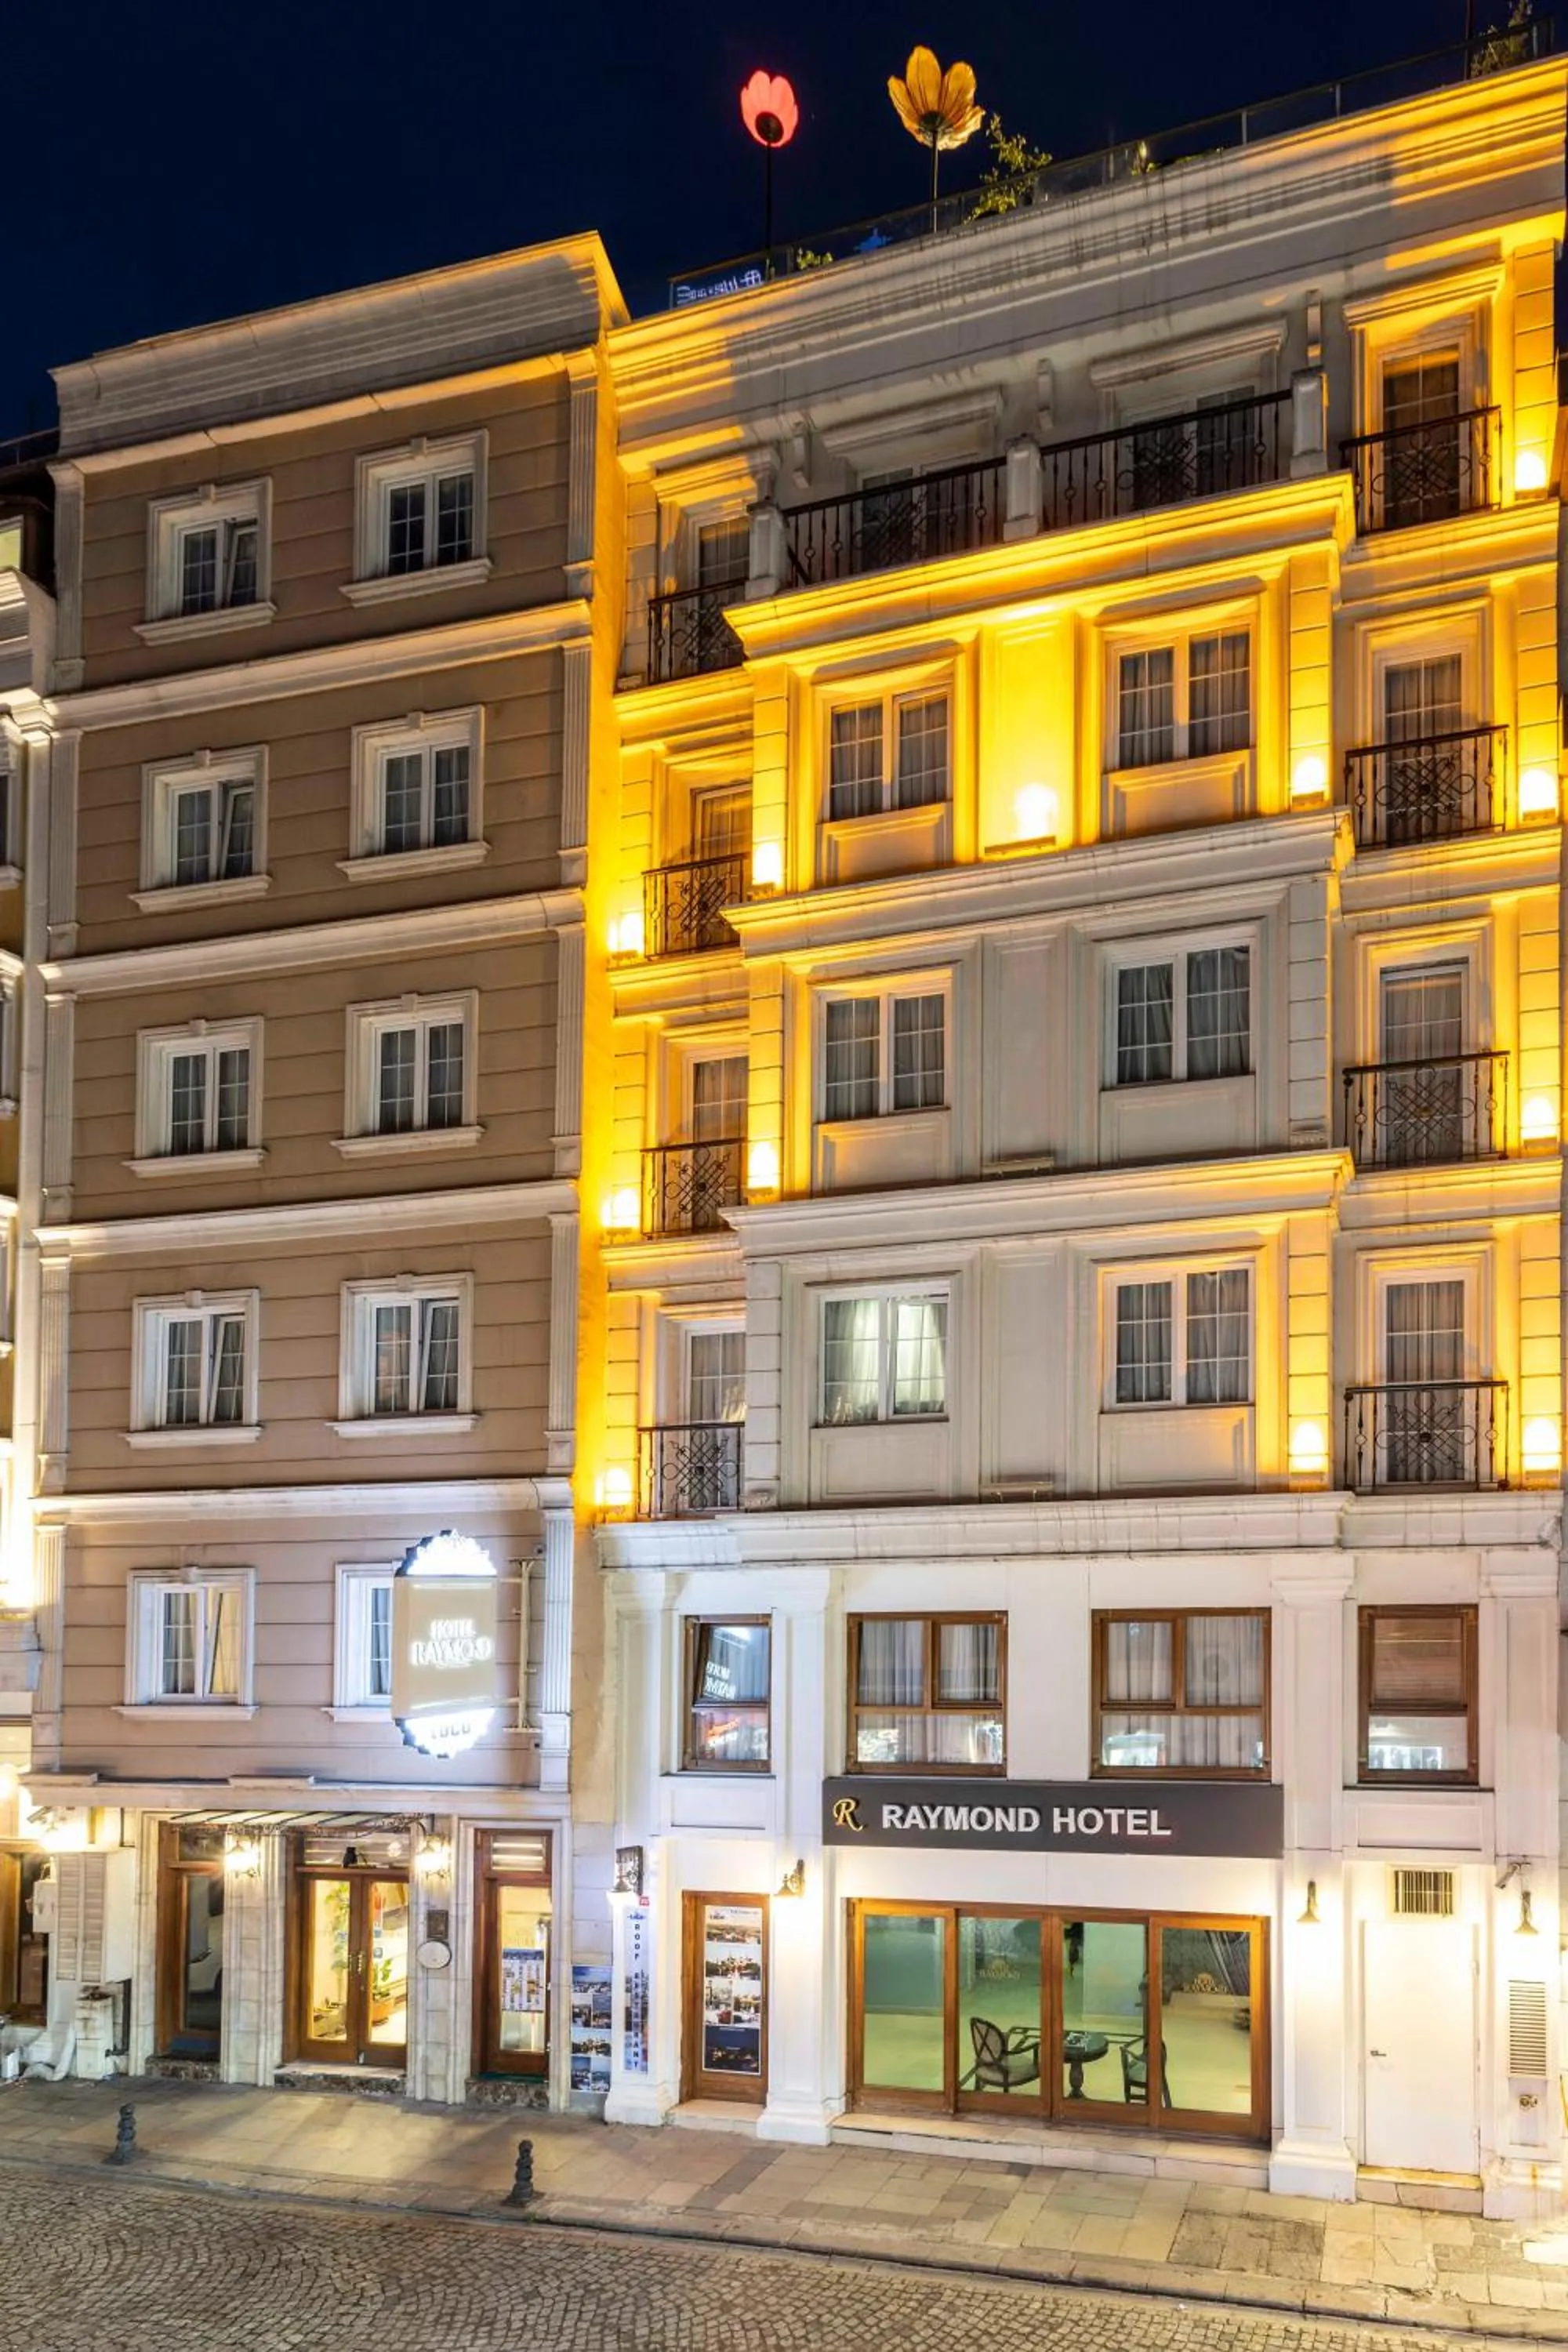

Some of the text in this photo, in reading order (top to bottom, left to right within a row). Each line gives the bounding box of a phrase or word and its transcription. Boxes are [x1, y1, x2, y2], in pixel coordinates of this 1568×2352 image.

[430, 1618, 477, 1640] HOTEL
[833, 1798, 1172, 1835] R RAYMOND HOTEL
